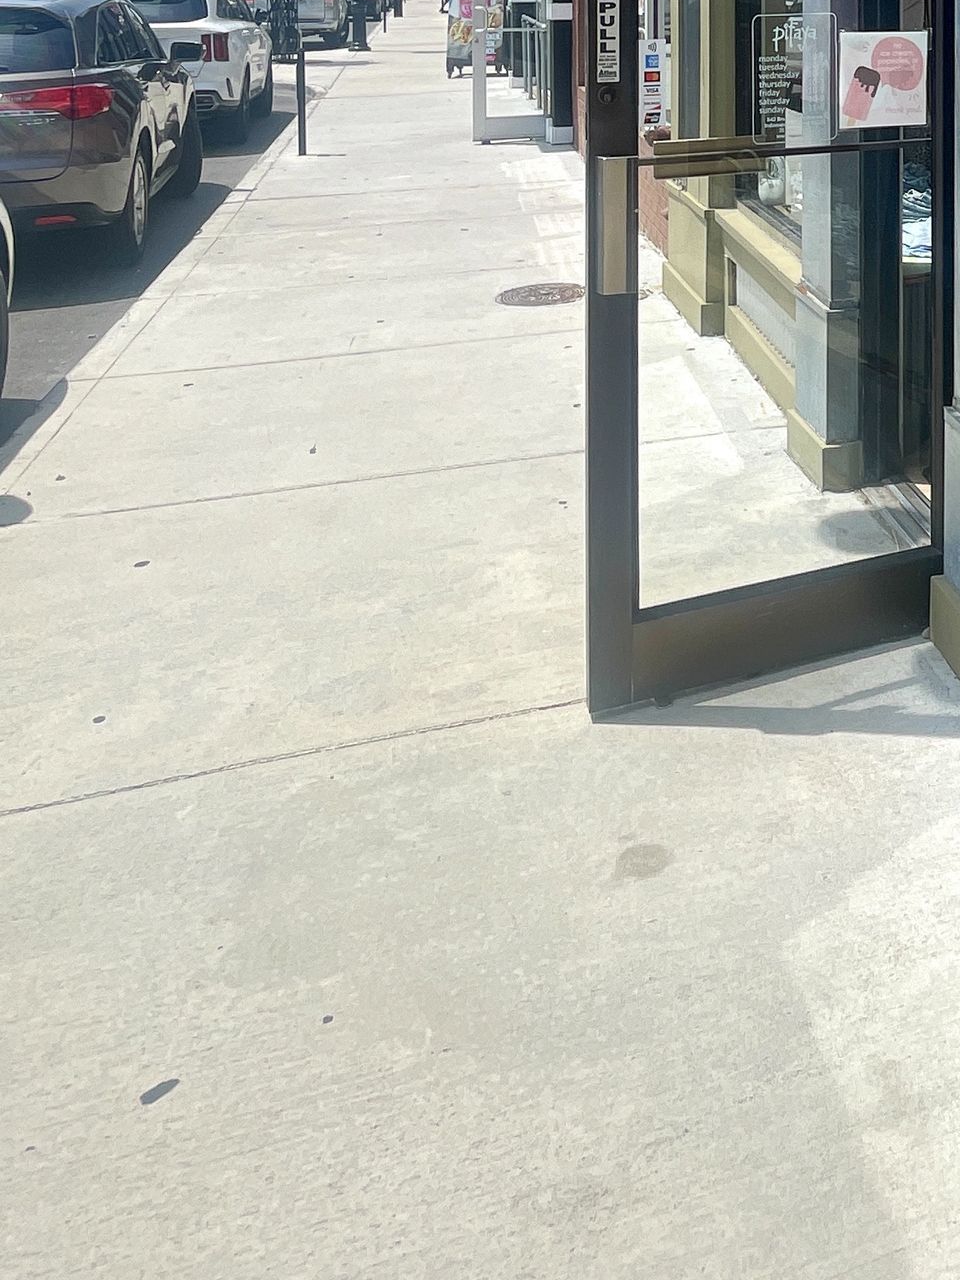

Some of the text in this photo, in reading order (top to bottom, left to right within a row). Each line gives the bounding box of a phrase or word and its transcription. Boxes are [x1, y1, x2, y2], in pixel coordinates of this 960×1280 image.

[599, 1, 617, 54] PULL
[772, 17, 818, 52] pitaya
[758, 55, 788, 63] monday
[758, 64, 787, 72] tuesday
[758, 72, 799, 80] wednesday
[759, 81, 791, 89] thursday
[759, 89, 780, 98] friday
[758, 98, 790, 106] saturday
[758, 107, 785, 115] sunday
